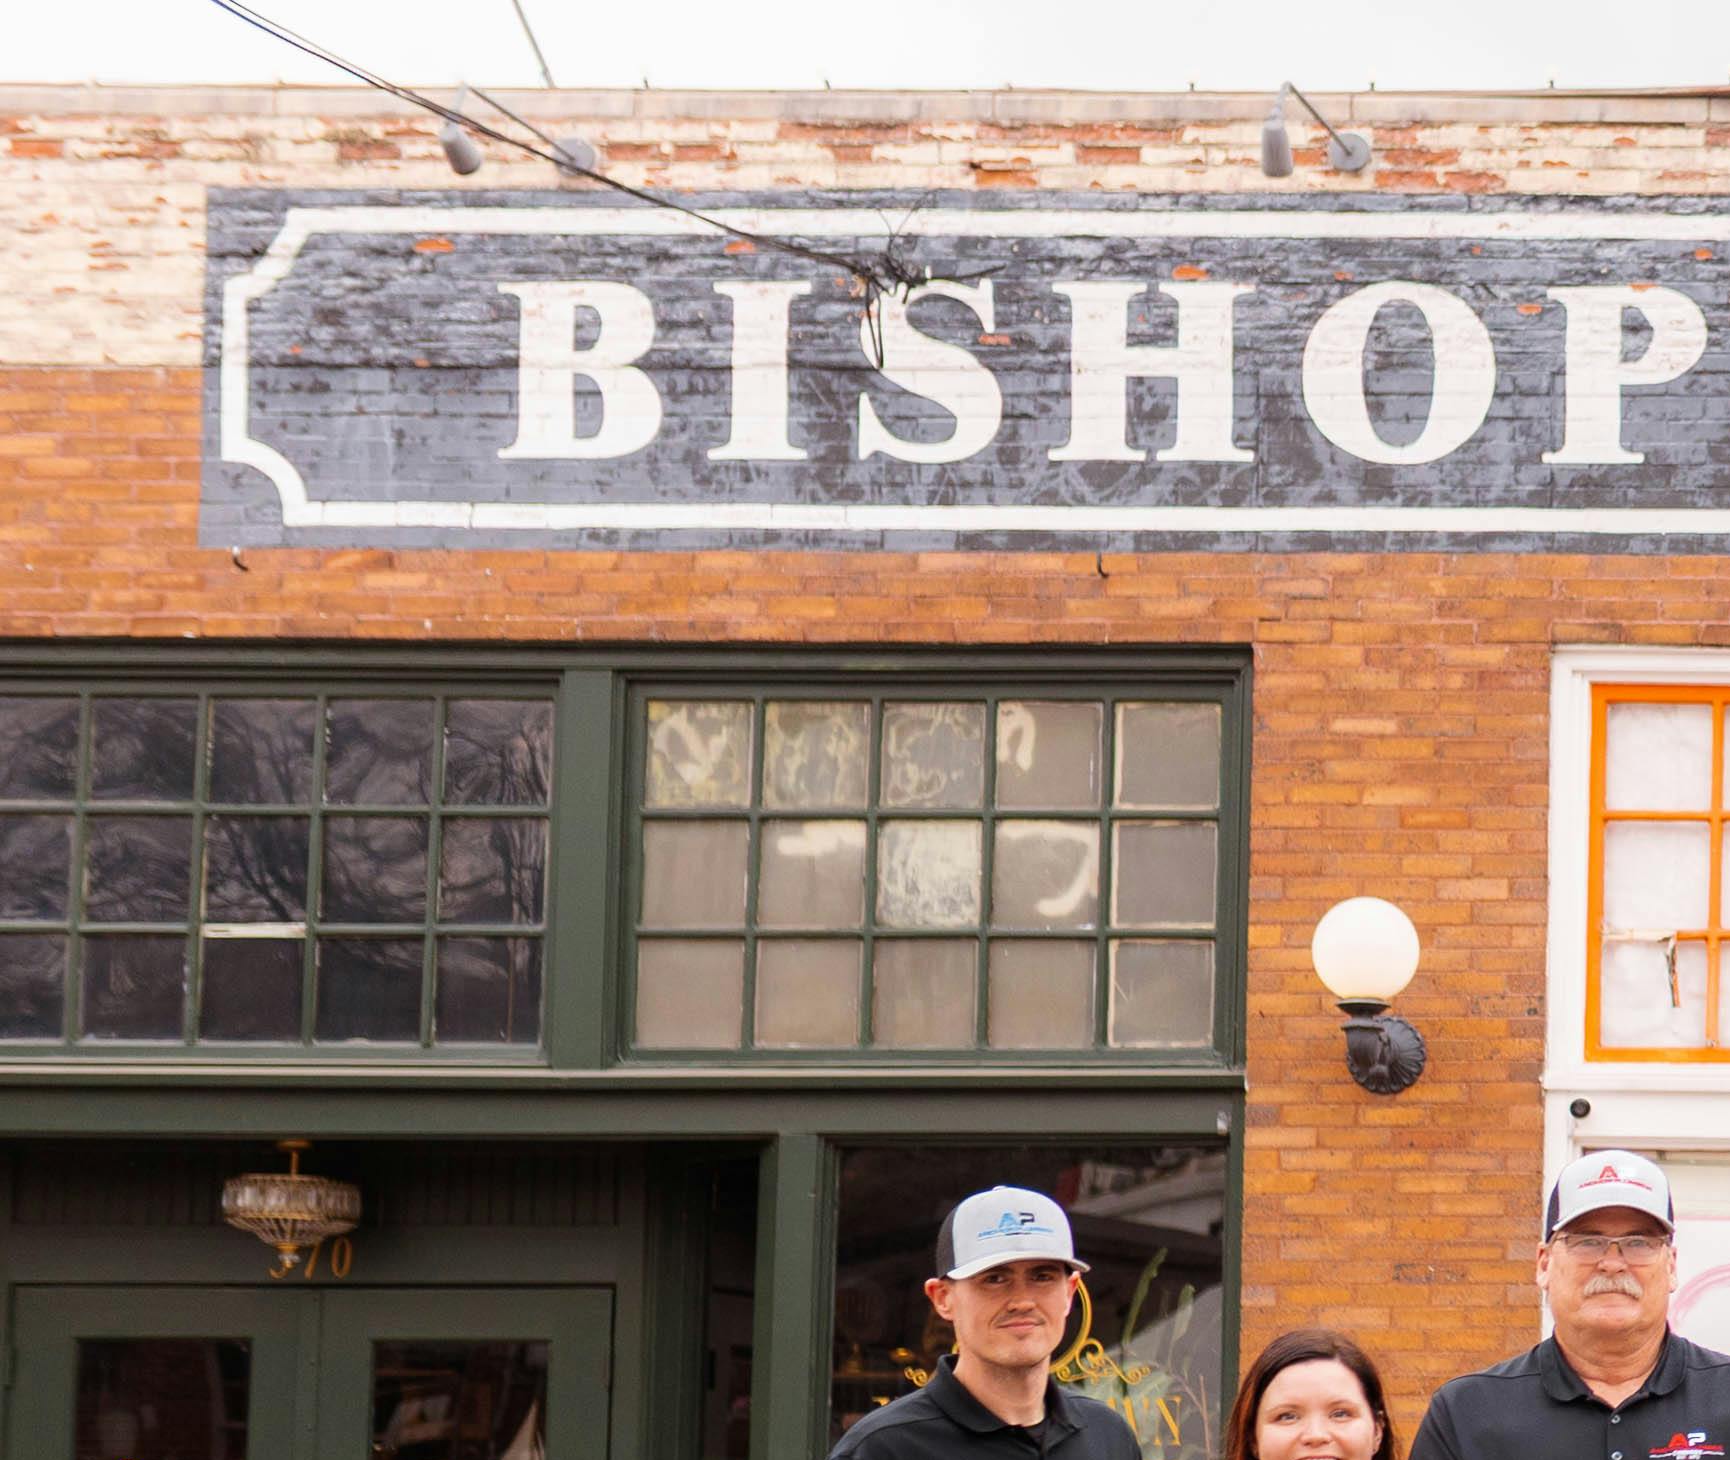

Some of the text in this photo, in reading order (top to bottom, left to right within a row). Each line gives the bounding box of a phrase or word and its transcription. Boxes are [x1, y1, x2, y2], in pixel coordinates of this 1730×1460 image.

[497, 280, 1709, 465] BISHOP
[268, 1236, 352, 1280] 70
[1668, 1432, 1706, 1448] AP
